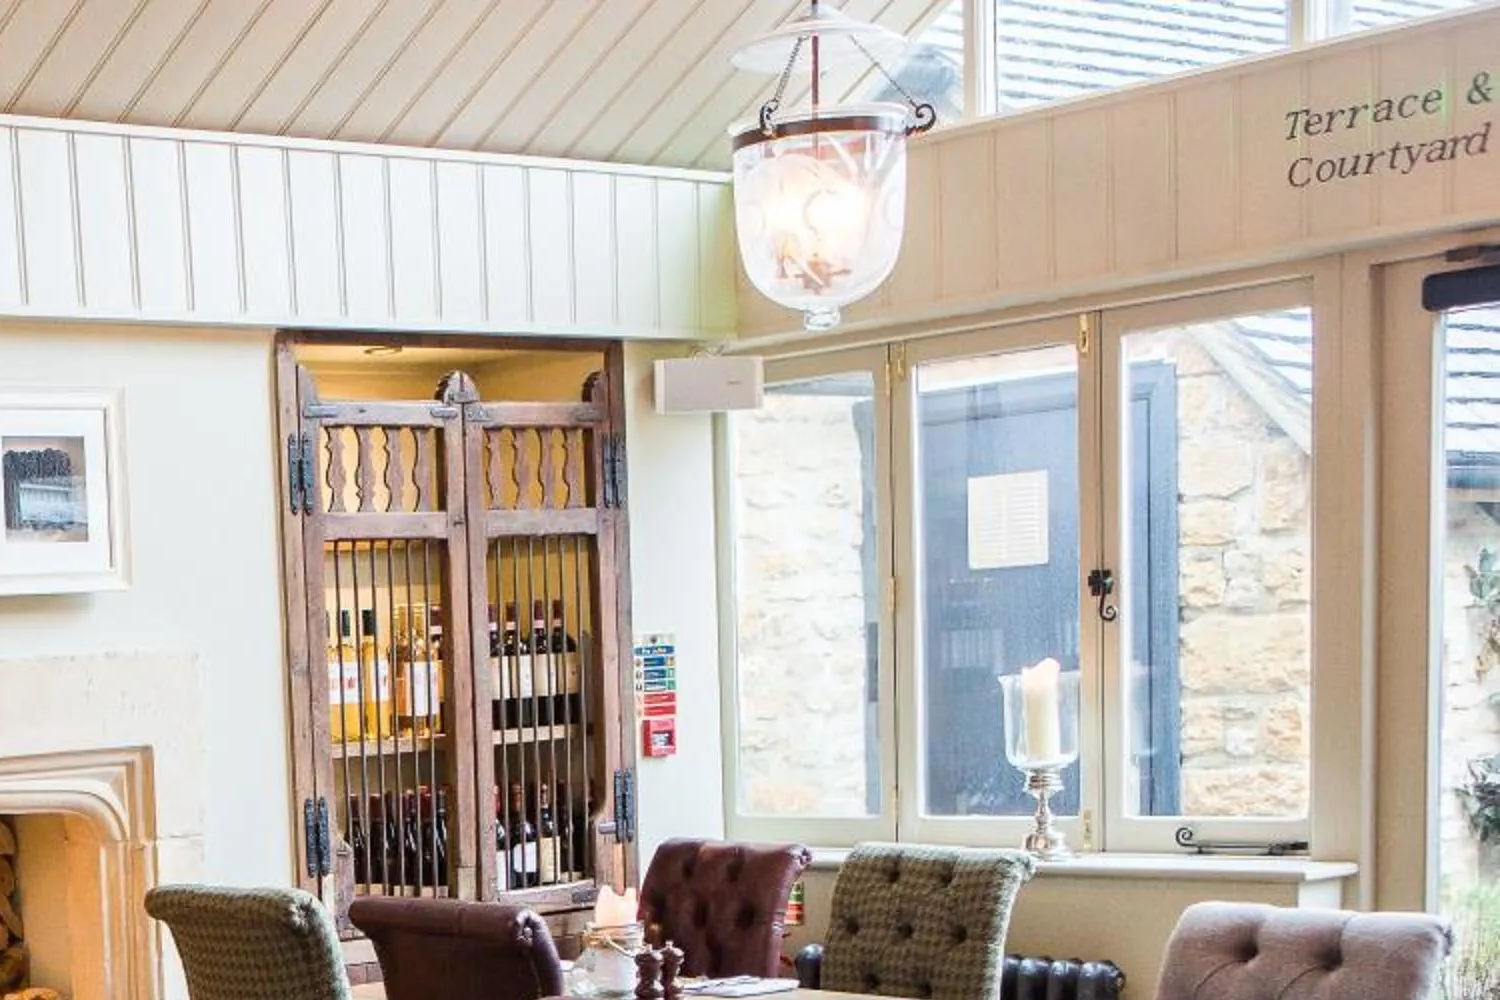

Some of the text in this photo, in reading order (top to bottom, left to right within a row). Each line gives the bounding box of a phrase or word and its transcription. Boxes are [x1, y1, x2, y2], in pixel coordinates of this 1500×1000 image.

[1285, 71, 1493, 140] Terrace &
[1288, 121, 1492, 187] Courtyard
